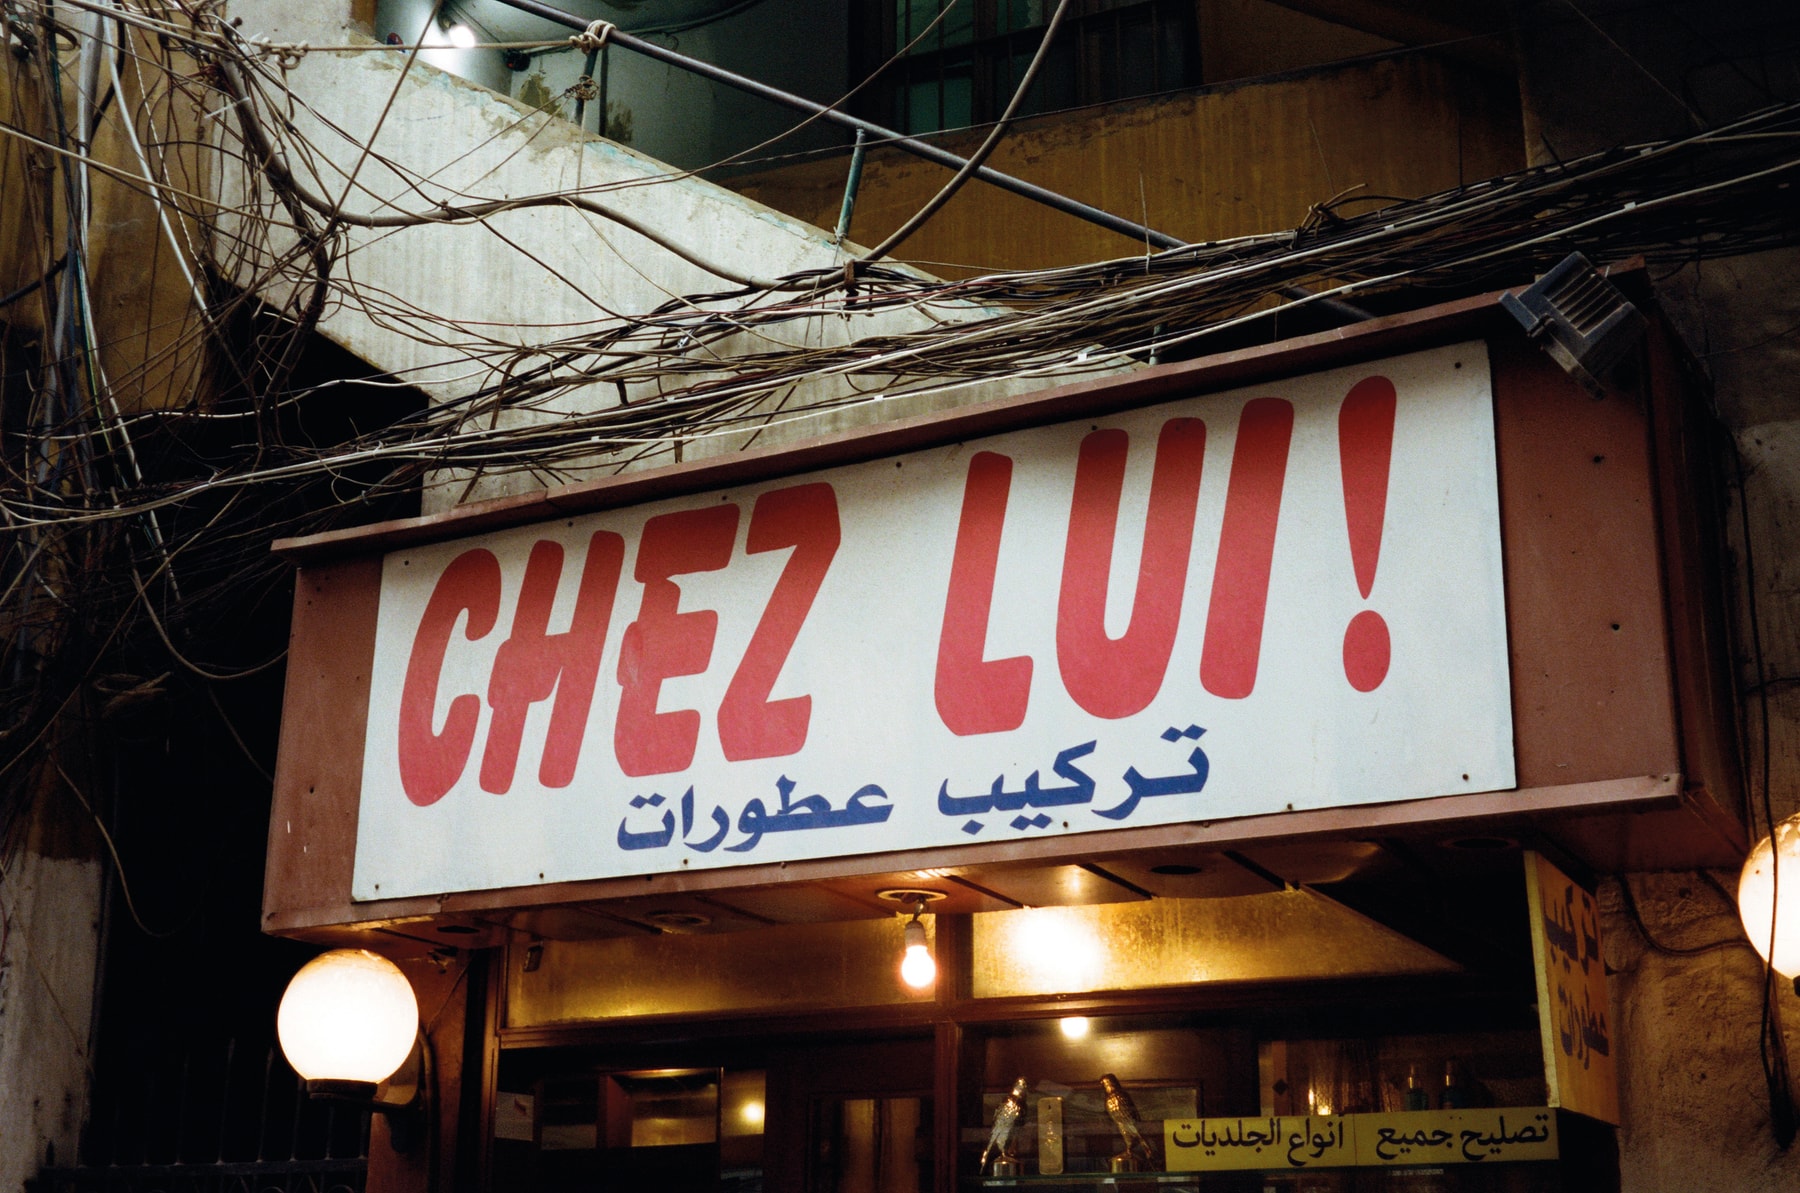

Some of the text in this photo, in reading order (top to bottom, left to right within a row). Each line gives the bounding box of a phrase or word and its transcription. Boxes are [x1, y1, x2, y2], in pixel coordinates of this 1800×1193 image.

[397, 480, 842, 807] CHEZ
[617, 724, 1211, 854] تركيب عطورات
[1172, 1117, 1282, 1156] الجلديات
[1375, 1127, 1453, 1160] جميع
[1460, 1114, 1550, 1161] تصليح
